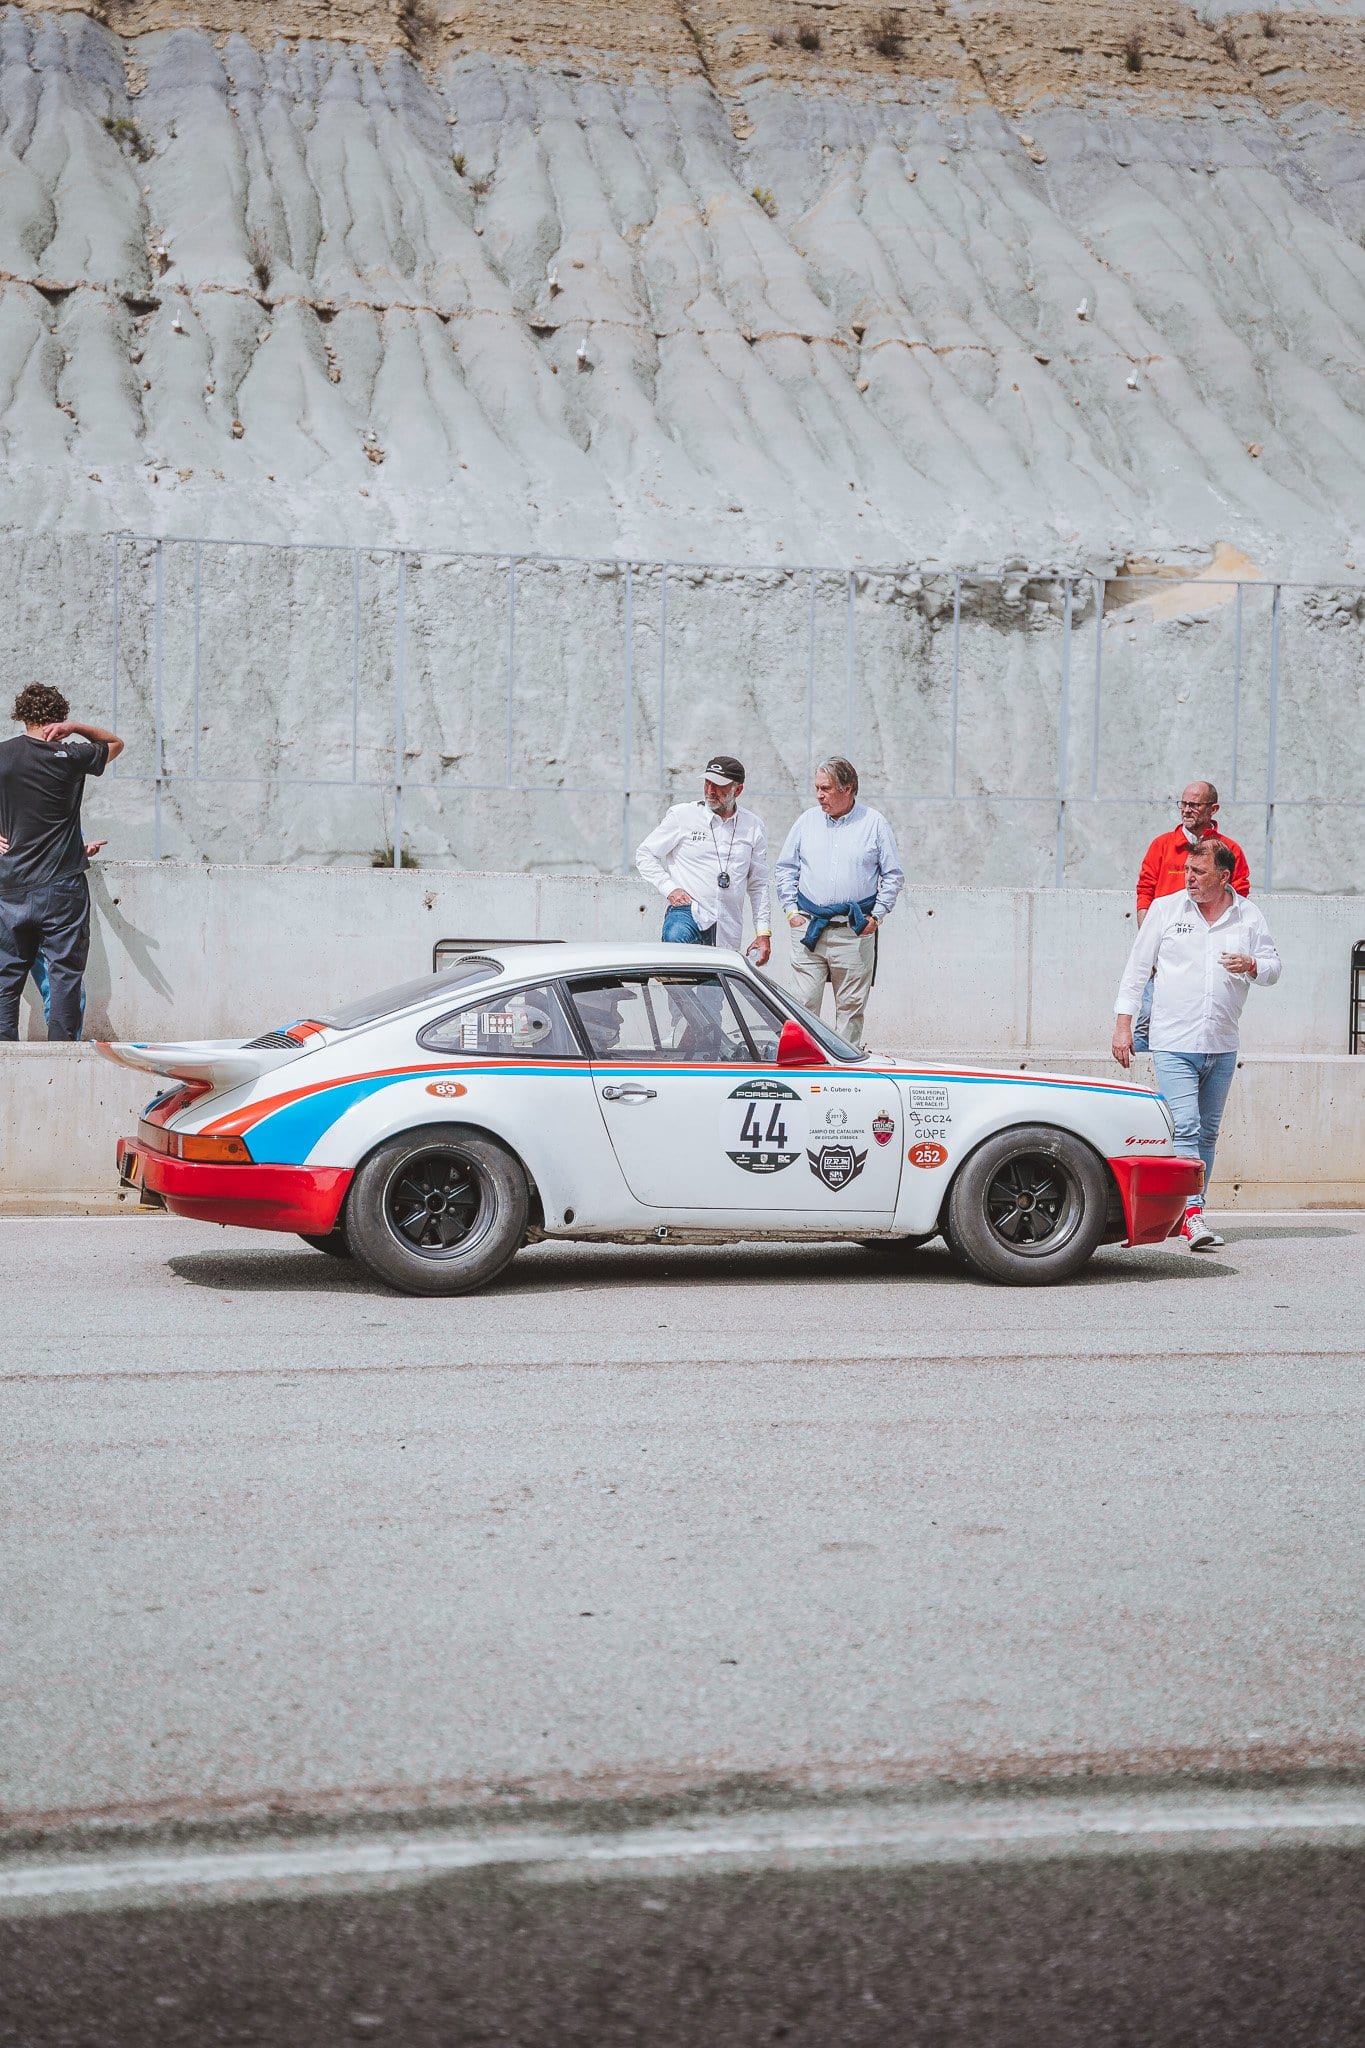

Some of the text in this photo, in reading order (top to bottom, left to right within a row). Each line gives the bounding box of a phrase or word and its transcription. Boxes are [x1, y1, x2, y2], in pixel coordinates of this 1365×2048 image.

[435, 1084, 457, 1094] 89
[736, 1091, 793, 1099] PORSCHE
[924, 1114, 952, 1123] GC24
[740, 1102, 788, 1149] 44
[1136, 1138, 1168, 1146] spark
[915, 1150, 941, 1163] 252
